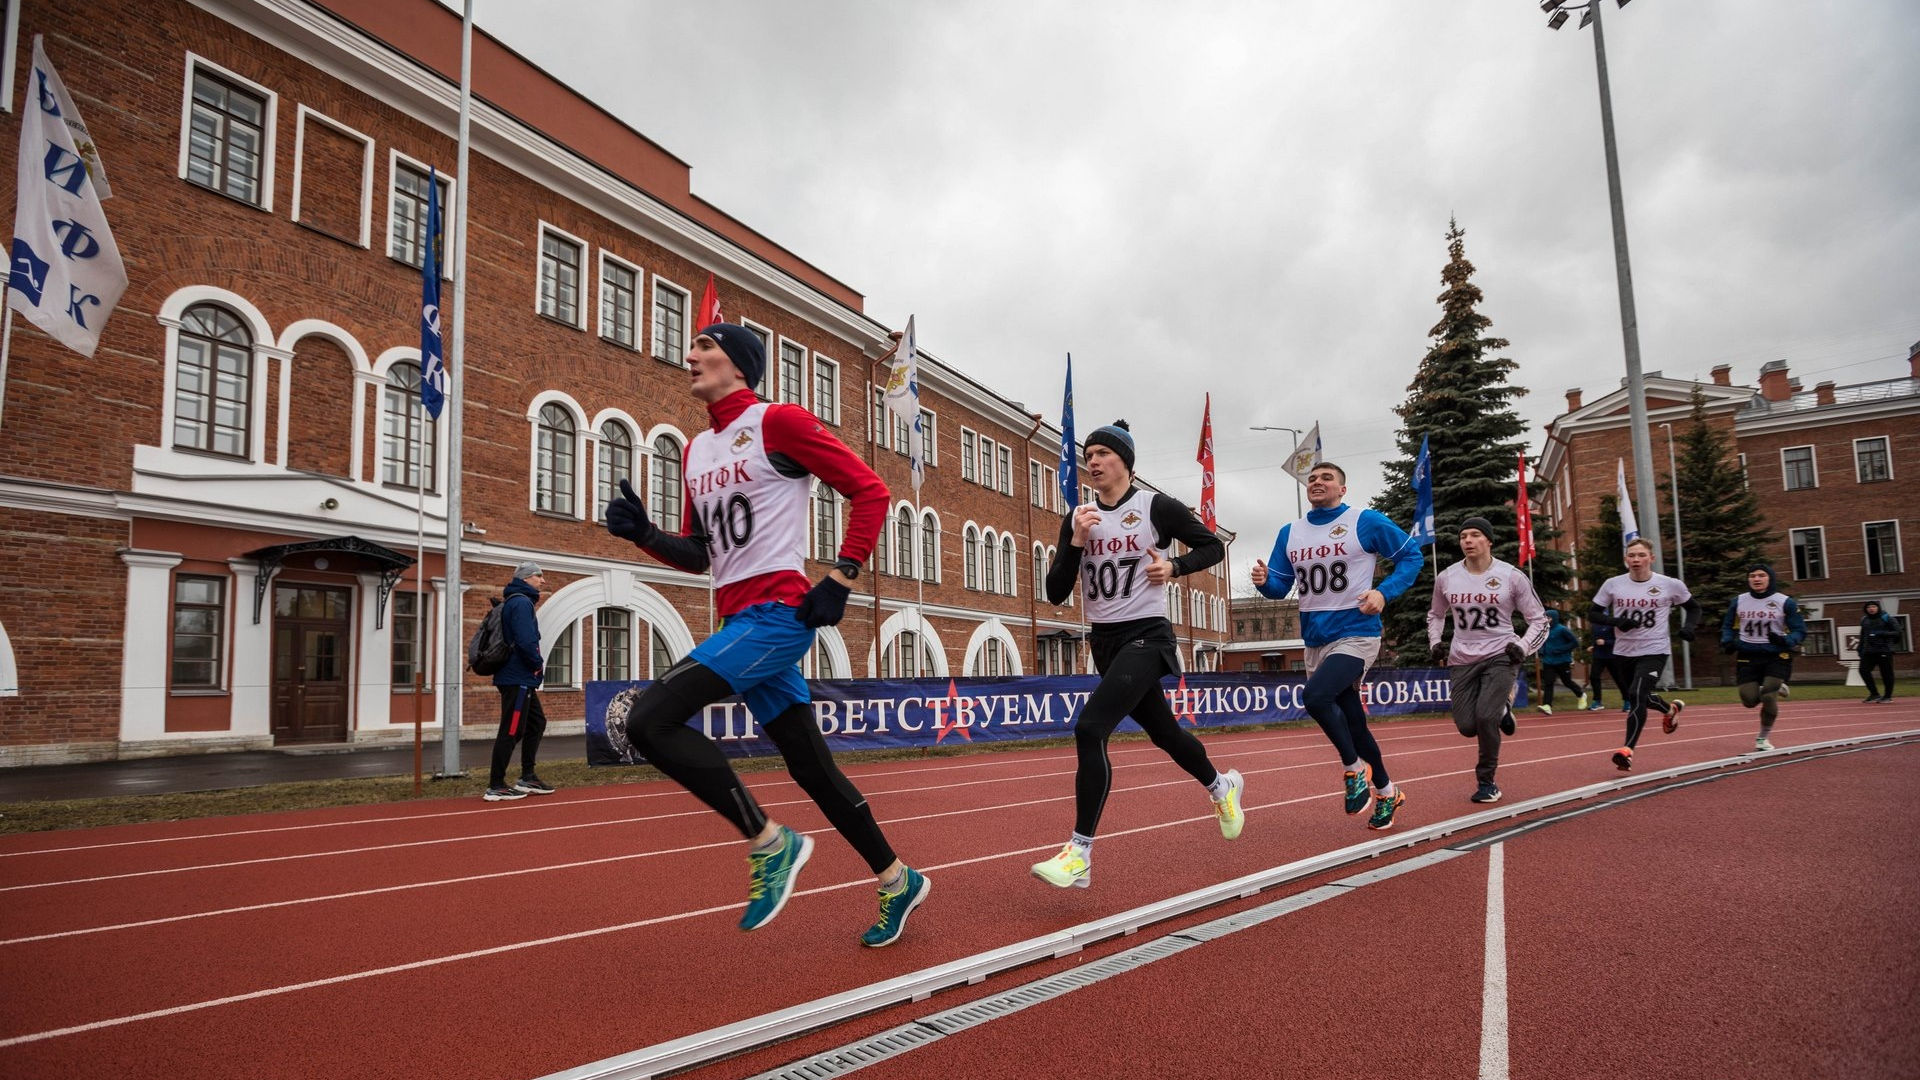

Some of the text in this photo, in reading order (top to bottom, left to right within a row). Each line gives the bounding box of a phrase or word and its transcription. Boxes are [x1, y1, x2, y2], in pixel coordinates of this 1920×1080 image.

[1290, 542, 1348, 564] ВИФК
[1085, 557, 1142, 601] 307
[1296, 560, 1349, 596] 308
[1450, 593, 1500, 604] ВИФК
[1616, 598, 1659, 608] ВИФК
[1455, 605, 1500, 631] 328
[1739, 610, 1777, 619] ВИФК
[1744, 620, 1771, 637] 411
